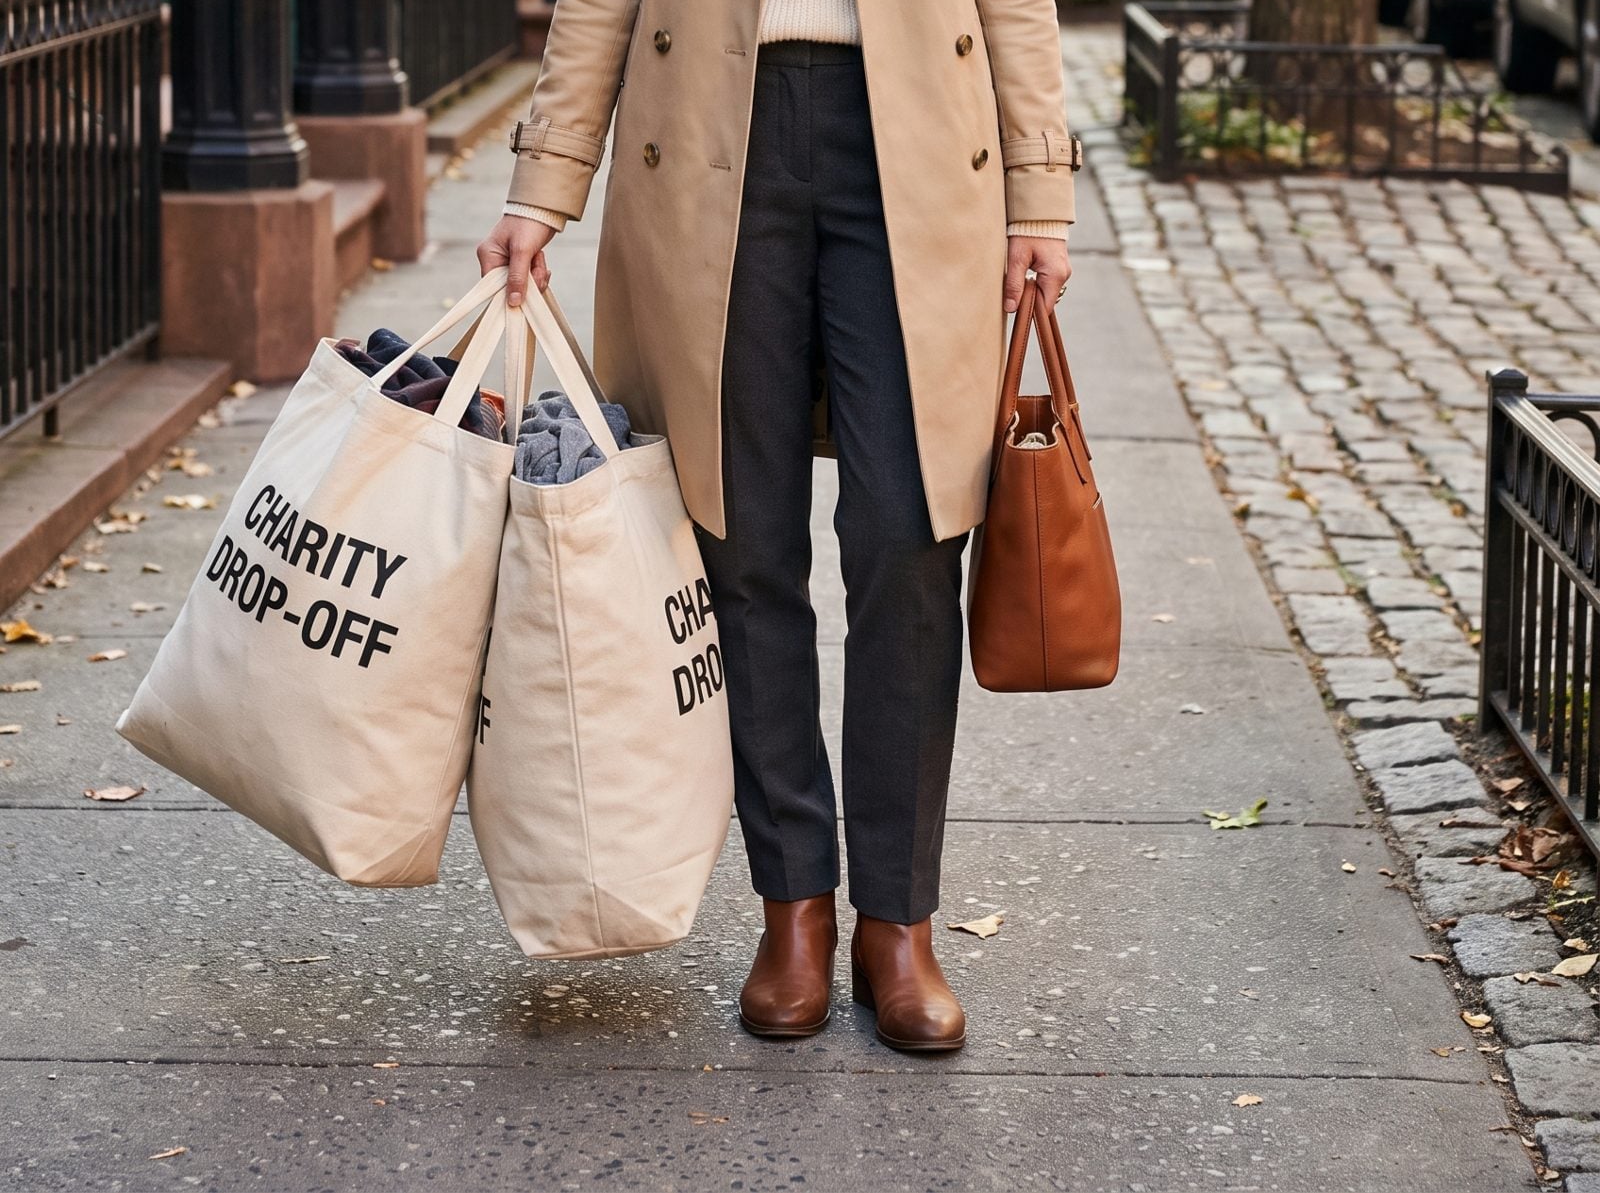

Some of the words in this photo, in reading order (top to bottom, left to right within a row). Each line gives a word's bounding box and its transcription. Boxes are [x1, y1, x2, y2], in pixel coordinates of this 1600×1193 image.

[244, 484, 408, 599] CHARITY
[206, 534, 399, 668] DROP-OFF
[672, 643, 723, 716] DRO
